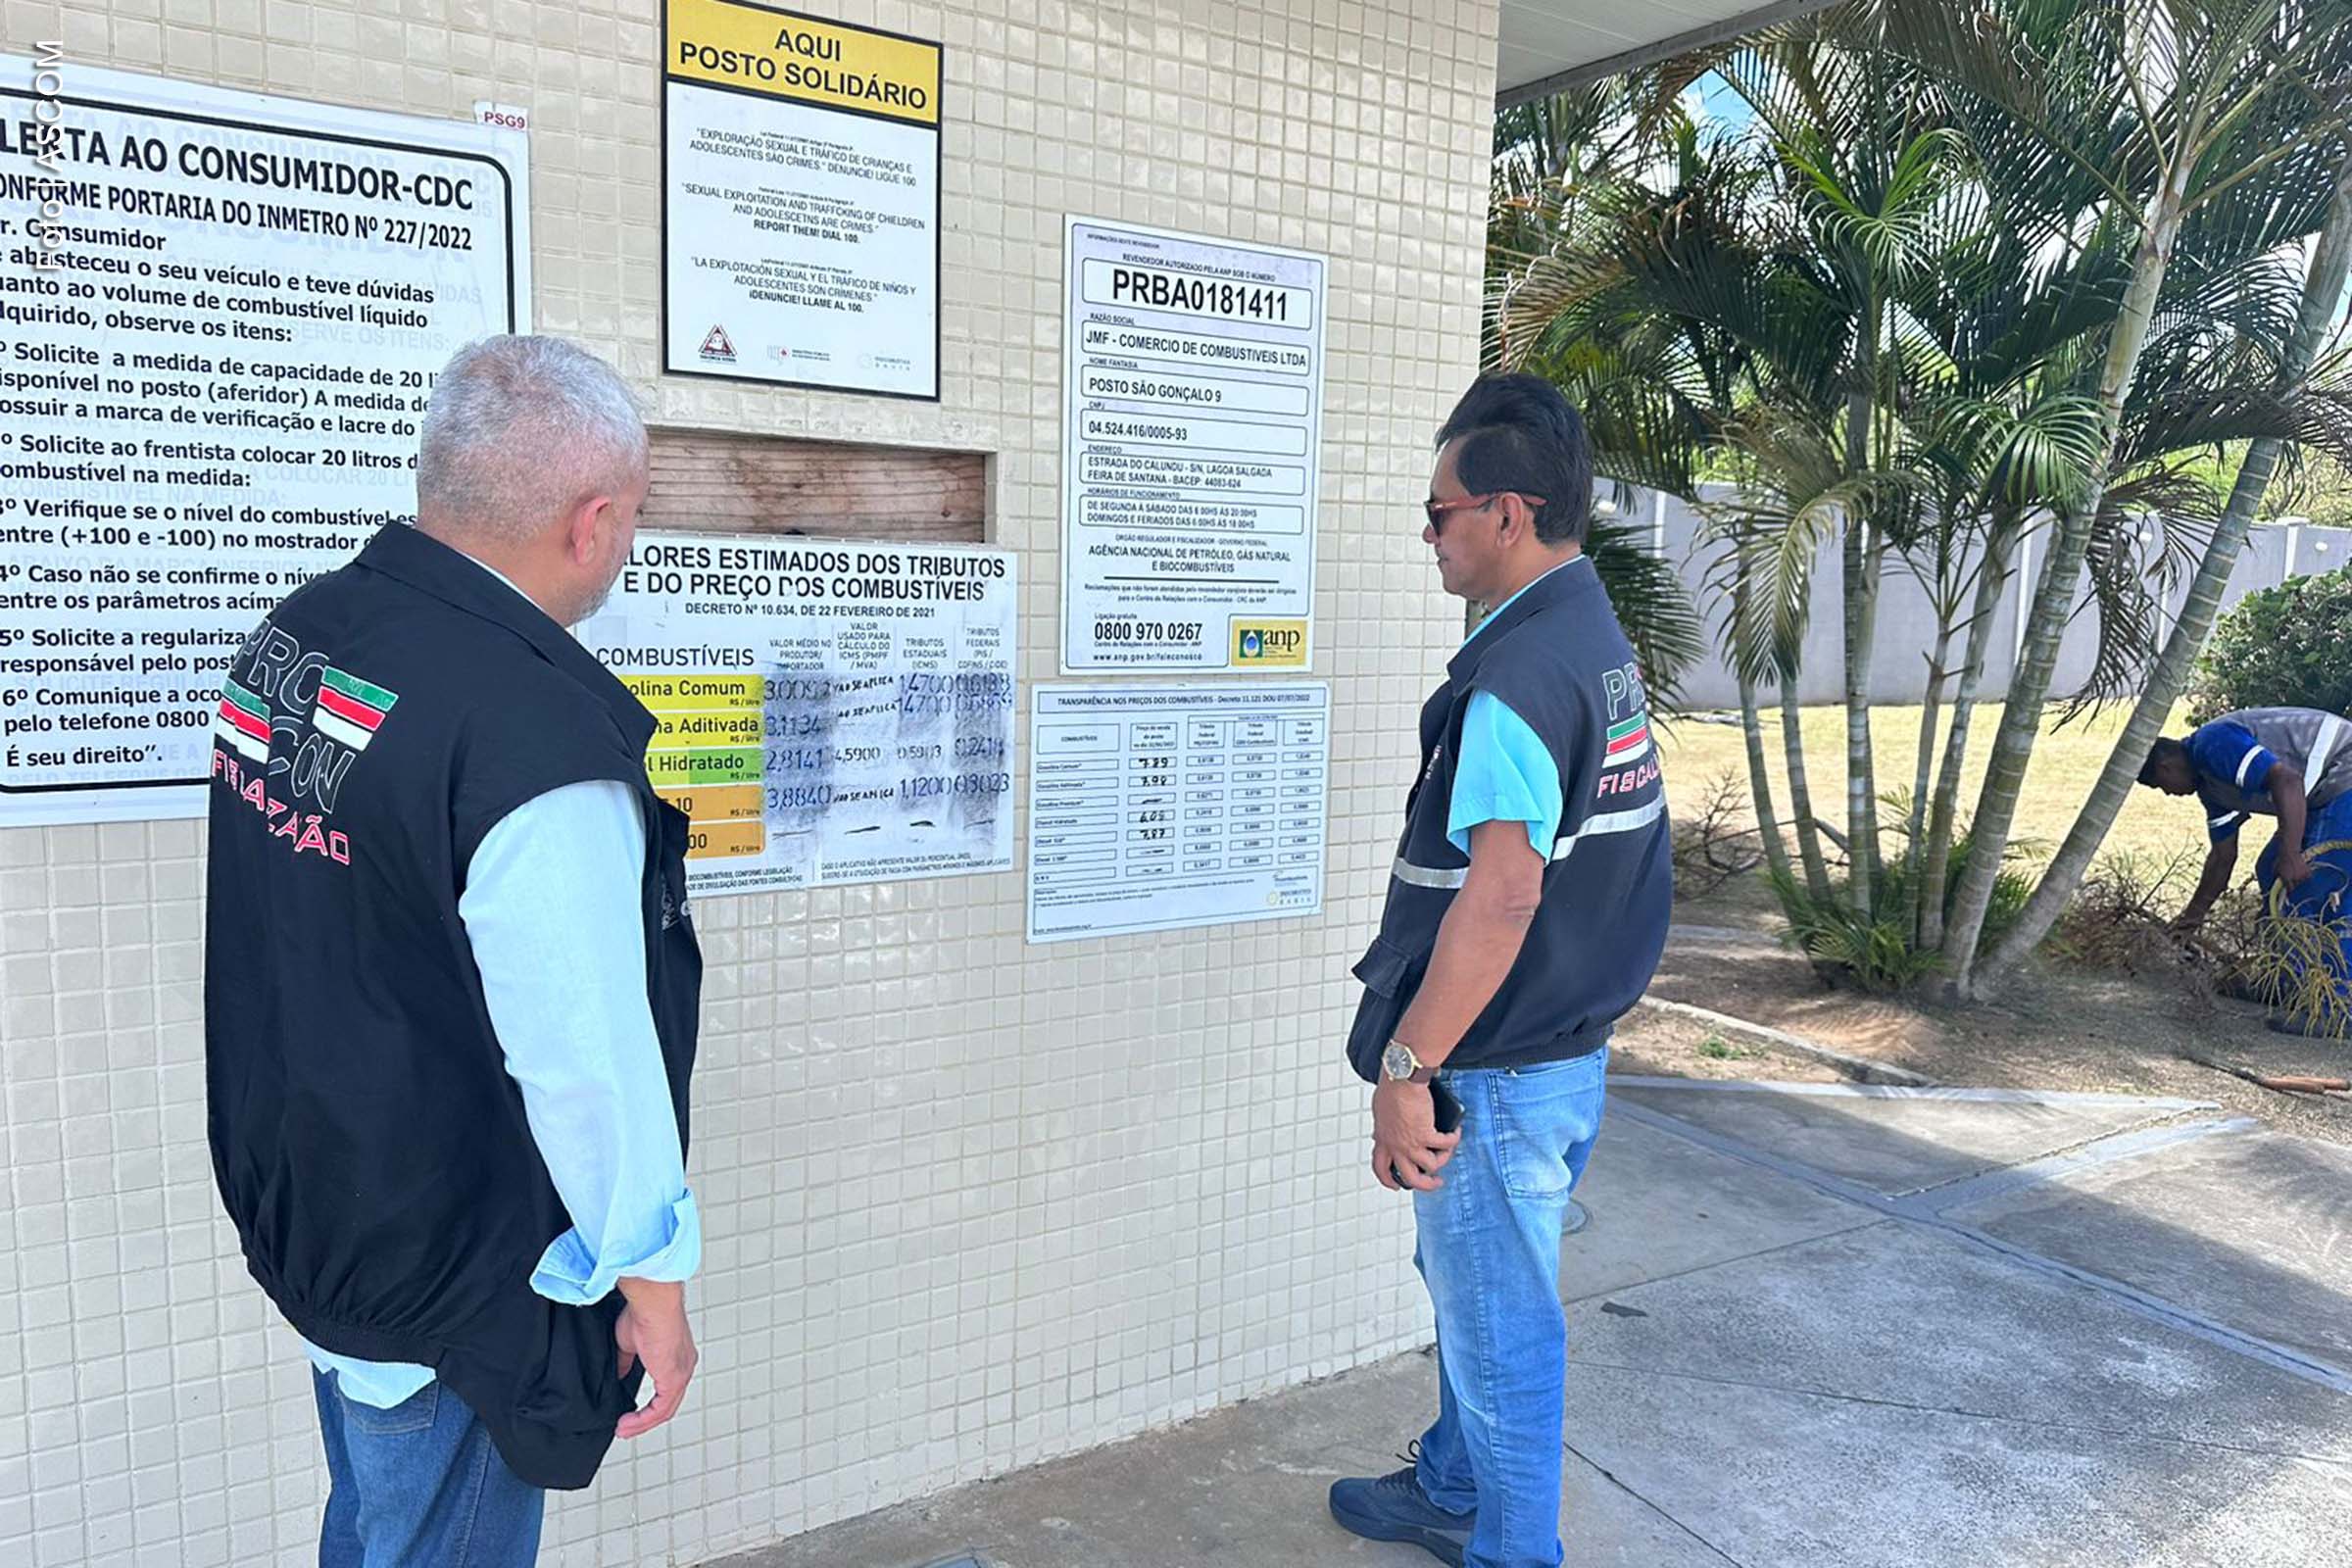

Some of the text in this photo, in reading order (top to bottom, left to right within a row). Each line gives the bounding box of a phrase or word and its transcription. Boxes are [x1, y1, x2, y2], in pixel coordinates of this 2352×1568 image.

[774, 28, 842, 62] AQUI
[680, 42, 927, 110] POSTO SOLIDÁRIO
[484, 111, 525, 129] PSG9
[690, 140, 763, 161] ADOLESCENTES
[765, 139, 800, 155] SEXUAL
[121, 135, 168, 172] AO
[178, 142, 473, 210] CONSUMIDOR-CDC
[108, 185, 217, 222] PORTARIA
[222, 199, 251, 226] DO
[258, 204, 349, 237] INMETRO
[383, 218, 472, 250] 227/2022
[25, 218, 167, 251] Cnsumidor
[754, 219, 790, 232] REPORT
[822, 229, 841, 241] DIAL
[10, 245, 434, 304] abasteceu seu veículo teve dúvidas
[68, 281, 427, 327] ao volume de combustível líquido
[803, 296, 832, 309] LLAME
[1112, 269, 1287, 321] PRBA0181411
[105, 310, 292, 342] observe os itens:
[1086, 330, 1306, 367] JMF COMERCIO DE COMBUSTIVEIS LTDA
[15, 342, 99, 366] Solicite
[133, 353, 212, 373] medida
[219, 357, 245, 375] de
[250, 361, 364, 384] capacidade
[400, 370, 422, 388] 20
[107, 377, 134, 394] no
[141, 380, 201, 399] posto
[209, 381, 308, 409] (aferidor)
[334, 392, 405, 412] medida
[1090, 377, 1221, 403] POSTO SÃO GONÇALO 9
[96, 404, 416, 436] marca verificação lacre do
[20, 434, 402, 468] Solicite ao frentista colocar 20 litros
[1088, 457, 1128, 469] ESTRADA
[133, 468, 251, 487] na medida:
[1088, 469, 1112, 481] FEIRA
[1128, 471, 1167, 484] SANTANA
[24, 498, 126, 522] Verifique
[133, 505, 157, 520] se
[183, 502, 233, 522] nível
[239, 505, 266, 523] do
[271, 507, 390, 526] combustível
[61, 525, 358, 551] (+100 -100) no mostrador
[624, 545, 1005, 578] LORES ESTIMADOS DOS TRIBUTOS
[1089, 545, 1128, 558] AGÊNCIA
[1130, 546, 1174, 559] NACIONAL
[1176, 548, 1188, 559] DE
[28, 564, 260, 585] Caso não se confirme
[1159, 560, 1235, 573] BIOCOMBUSTÍVEIS
[624, 571, 639, 593] E
[648, 572, 682, 594] DO
[691, 573, 771, 601] PREÇO
[832, 576, 985, 601] COMBUSTÍVEIS
[64, 594, 89, 610] os
[96, 590, 220, 612] parâmetros
[686, 603, 743, 614] DECRETO
[801, 605, 816, 616] DE
[818, 606, 831, 616] 22
[834, 606, 894, 617] FEVEREIRO
[896, 607, 910, 617] DE
[913, 607, 935, 618] 2021
[32, 628, 115, 647] Solicite
[1095, 622, 1131, 640] 0800
[1136, 622, 1163, 640] 970
[1167, 623, 1202, 640] 0267
[1263, 629, 1300, 653] anp
[1, 653, 187, 676] responsável pelo
[596, 645, 755, 667] COMBUSTÍVEIS
[2, 686, 161, 708] 6º Comunique
[630, 680, 746, 697] olina Comum
[4, 710, 209, 736] pelo telefone 0800
[678, 717, 759, 734] Aditivada
[26, 750, 66, 767] seu
[660, 754, 745, 771] Hidratado
